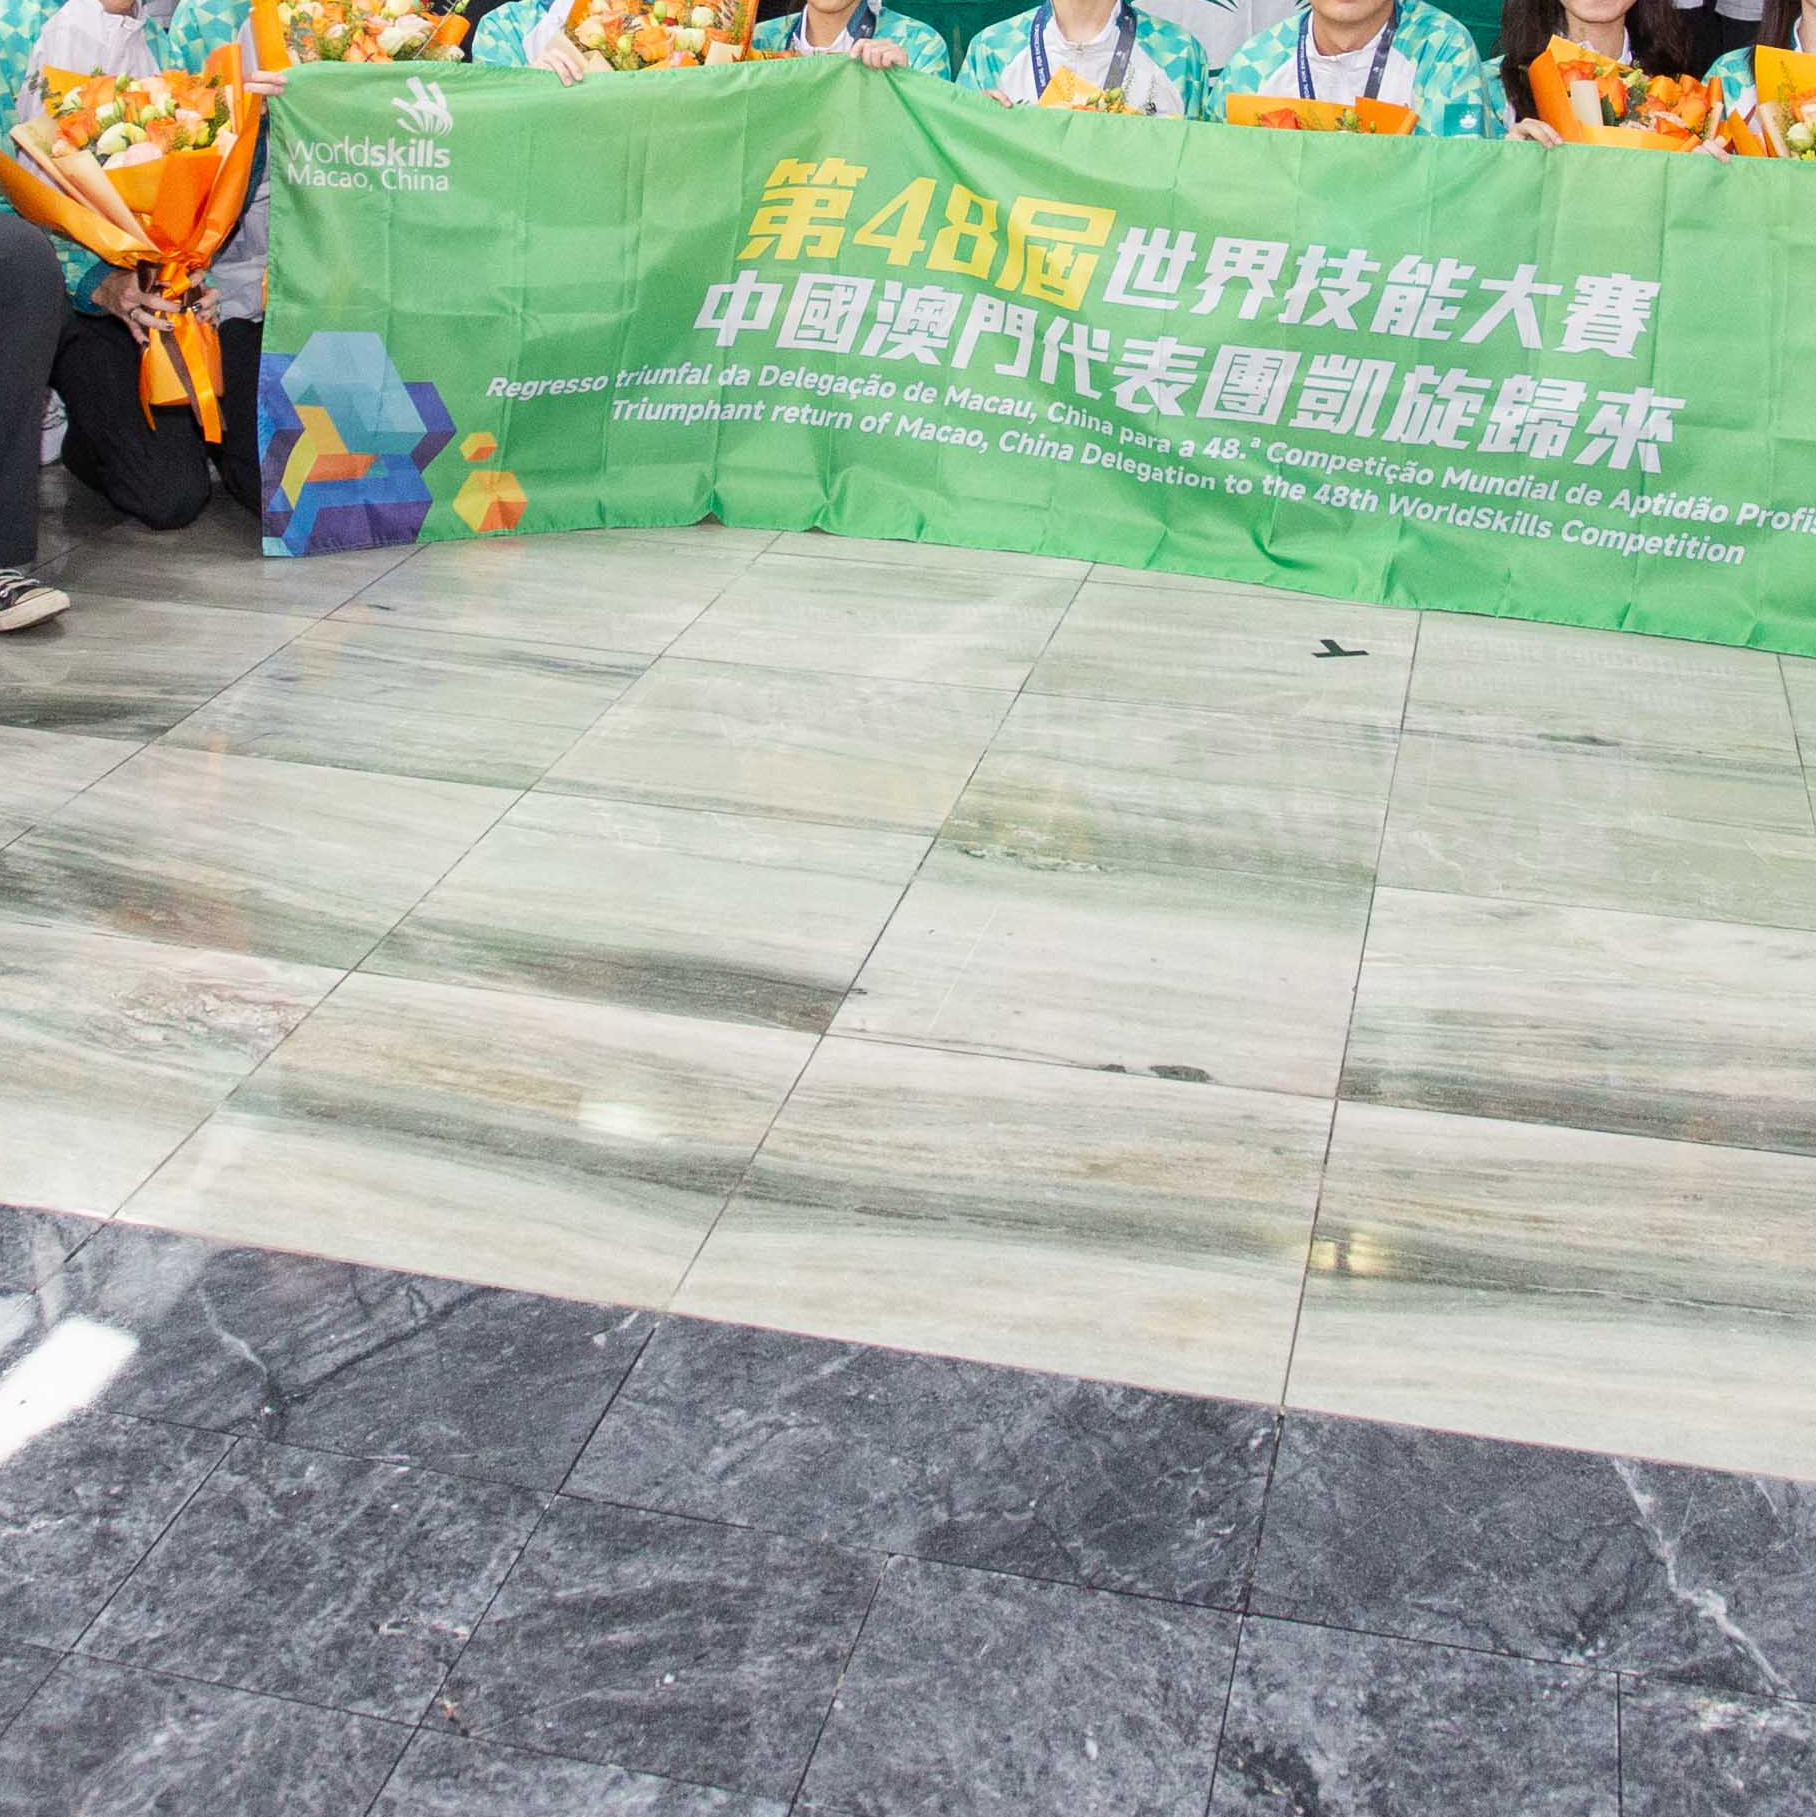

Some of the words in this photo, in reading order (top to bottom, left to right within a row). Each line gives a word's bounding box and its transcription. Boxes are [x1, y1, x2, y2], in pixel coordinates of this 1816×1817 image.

[287, 162, 374, 193] Macao,
[380, 167, 450, 192] China
[289, 135, 451, 169] worldskills
[486, 376, 608, 401] Regresso
[615, 362, 713, 389] triunfal
[717, 365, 751, 386] da
[758, 364, 896, 400] Delegação
[903, 381, 938, 404] de
[943, 384, 1038, 423] Macau,
[1047, 402, 1114, 436] China
[1119, 424, 1172, 454] para
[1178, 438, 1195, 458] a
[1265, 441, 1434, 486] Competição
[1440, 466, 1560, 502] Mundial
[1565, 482, 1603, 507] de
[1608, 488, 1730, 524] Aptidão
[693, 270, 1686, 473] 中國澳門代表團凱旋歸來
[612, 398, 766, 426] Triumphant
[770, 402, 854, 431] return
[859, 411, 893, 435] of
[894, 415, 989, 454] Macao,
[998, 430, 1076, 462] China
[1080, 442, 1216, 491] Delegation
[1224, 474, 1253, 496] to
[1261, 472, 1307, 502] the
[1313, 484, 1380, 513] 48th
[1388, 492, 1553, 539] WorldSkills
[1561, 519, 1746, 565] Competition
